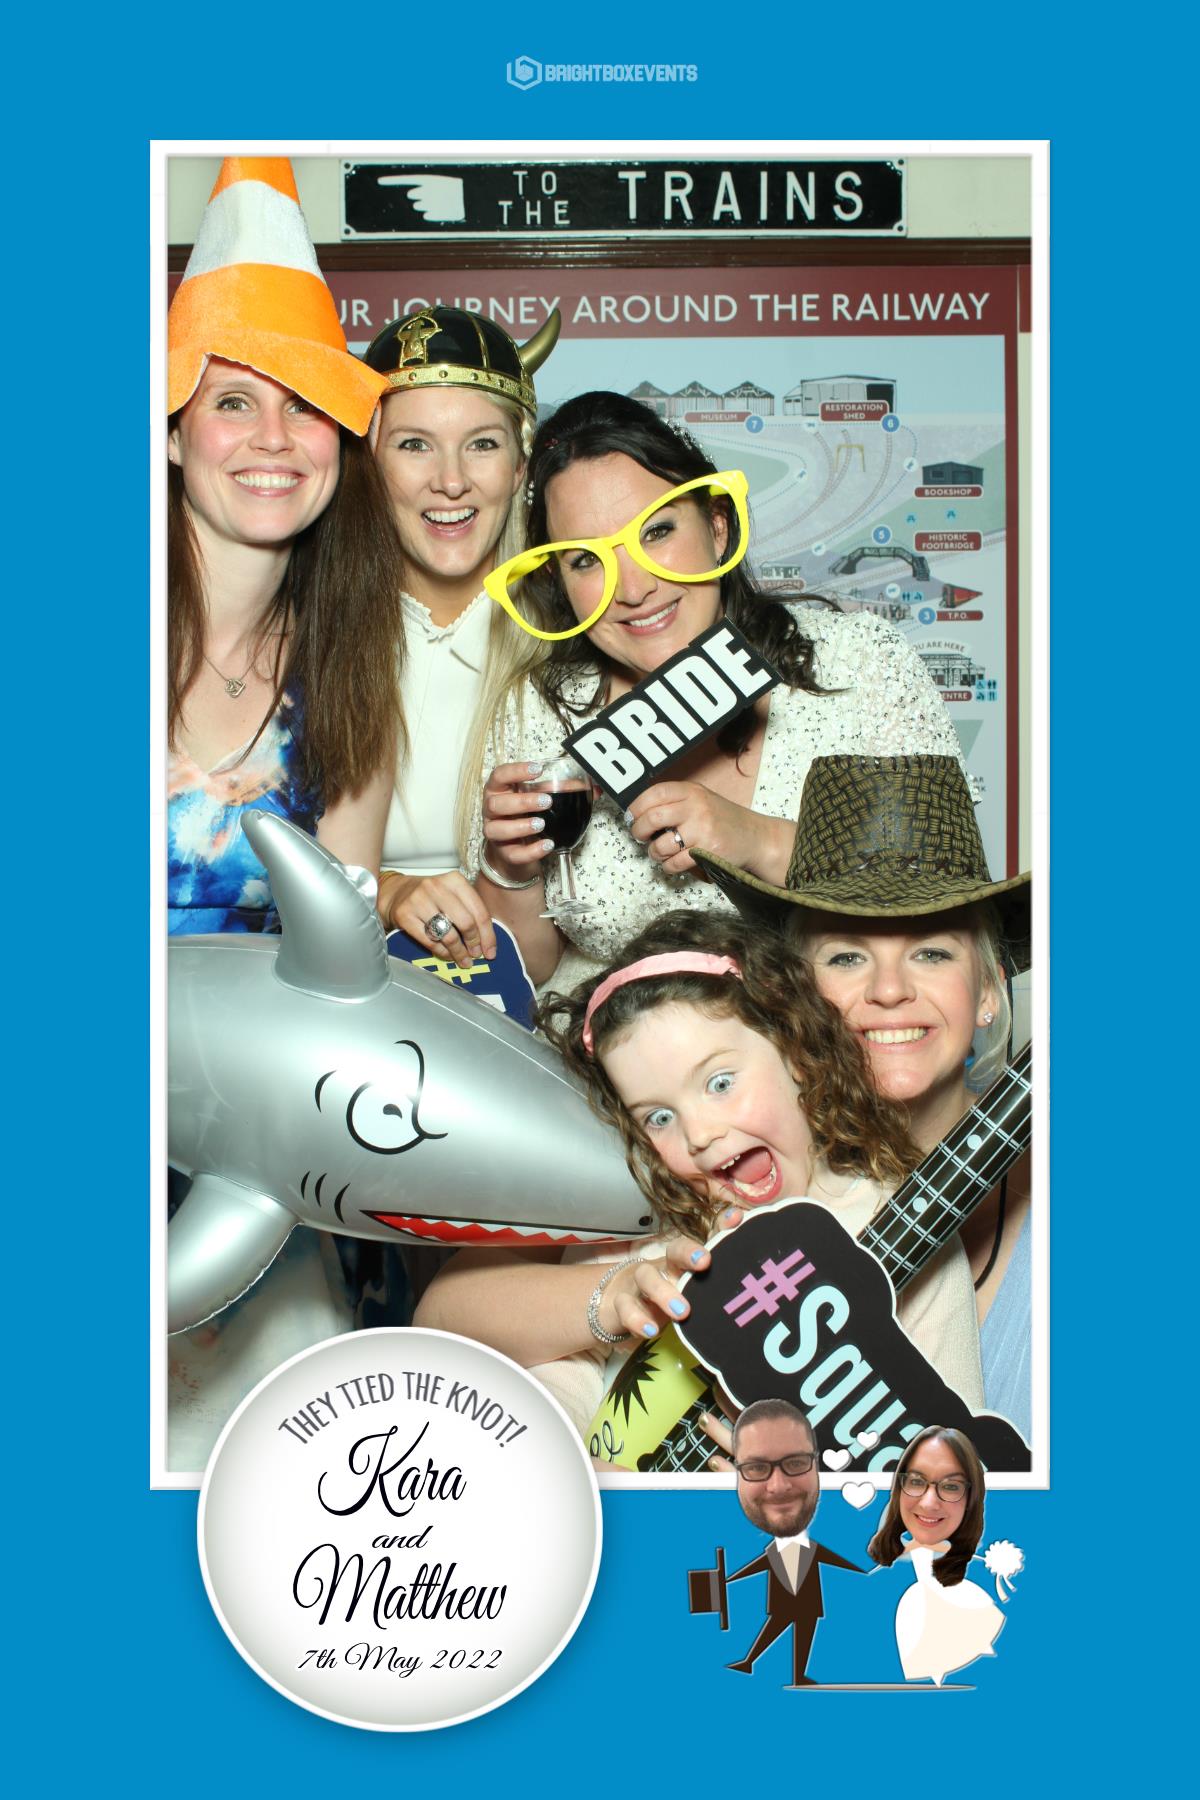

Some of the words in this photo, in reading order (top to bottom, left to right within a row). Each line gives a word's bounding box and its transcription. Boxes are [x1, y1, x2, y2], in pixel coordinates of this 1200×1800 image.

[513, 170, 557, 195] TO
[618, 171, 865, 221] TRAINS
[498, 200, 570, 225] THE
[572, 295, 738, 323] AROUND
[749, 294, 819, 321] THE
[831, 293, 990, 321] RAILWAY
[825, 404, 883, 412] RESTORATION
[924, 488, 972, 496] BOOKSHOP
[922, 542, 975, 550] FOOTBRIDGE
[926, 641, 942, 649] ARE
[944, 641, 966, 653] HERE
[942, 691, 968, 699] ENTRE
[572, 628, 772, 795] BRIDE
